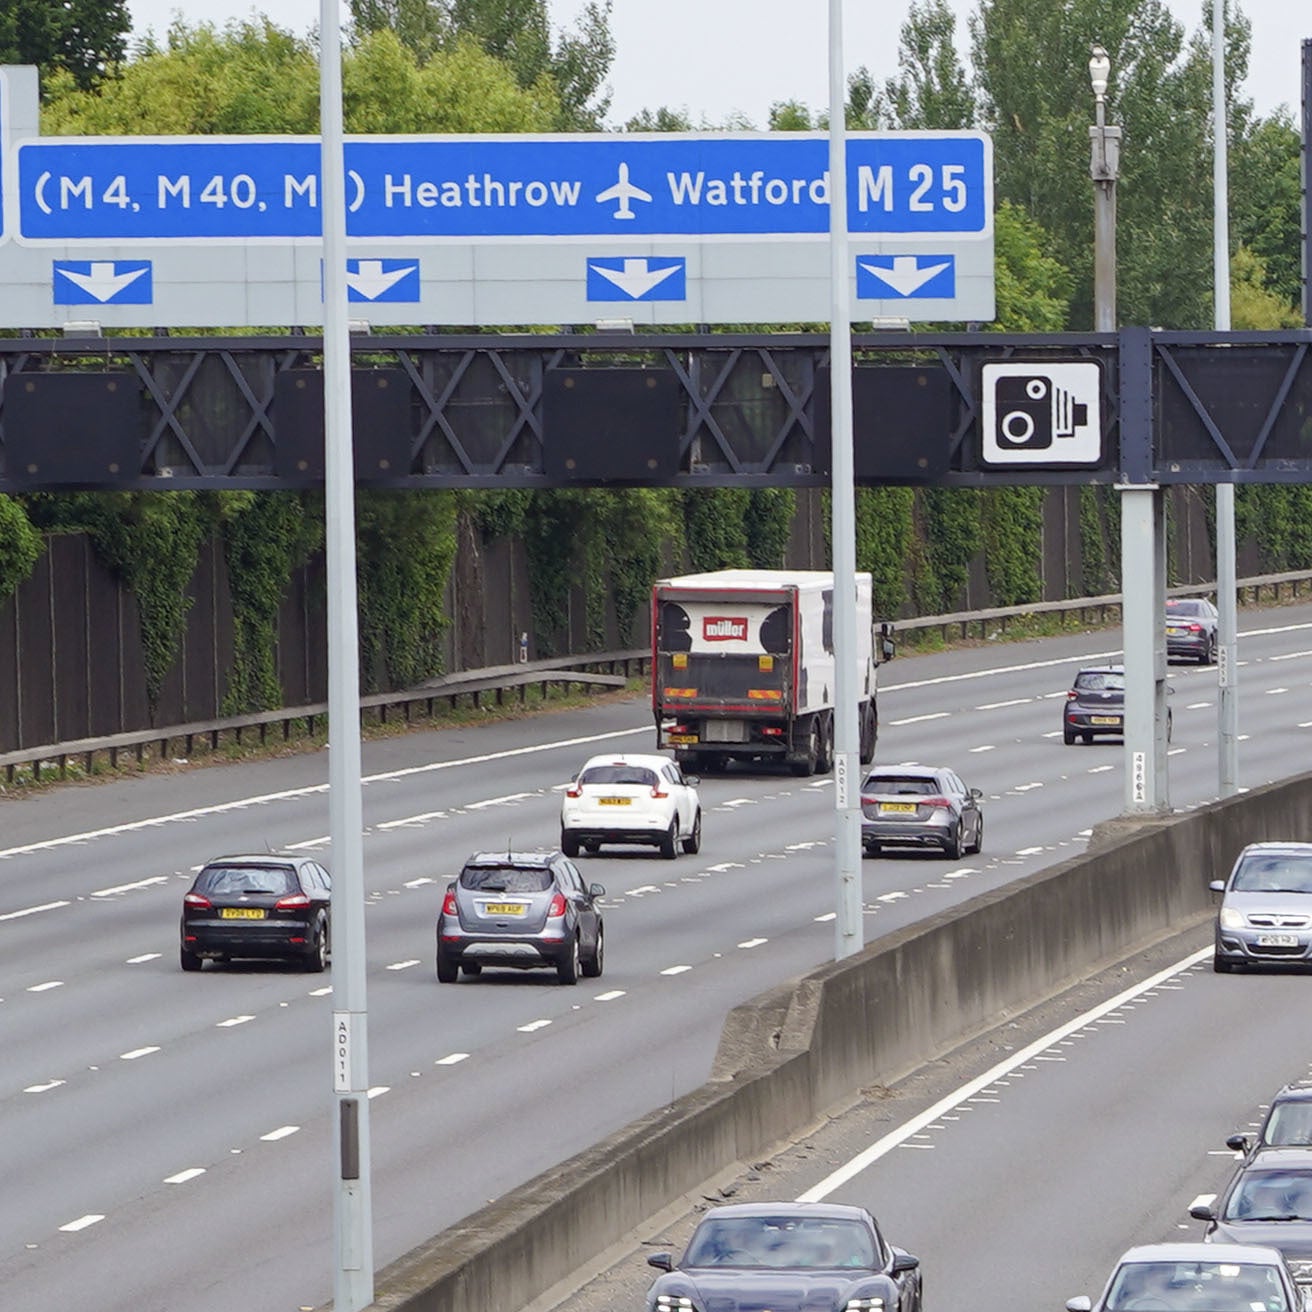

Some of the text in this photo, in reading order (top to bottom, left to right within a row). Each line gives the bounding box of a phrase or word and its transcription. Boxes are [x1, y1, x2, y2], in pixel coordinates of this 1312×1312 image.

[385, 173, 582, 208] Heathrow
[667, 171, 830, 205] Watford
[339, 1021, 347, 1082] AD011
